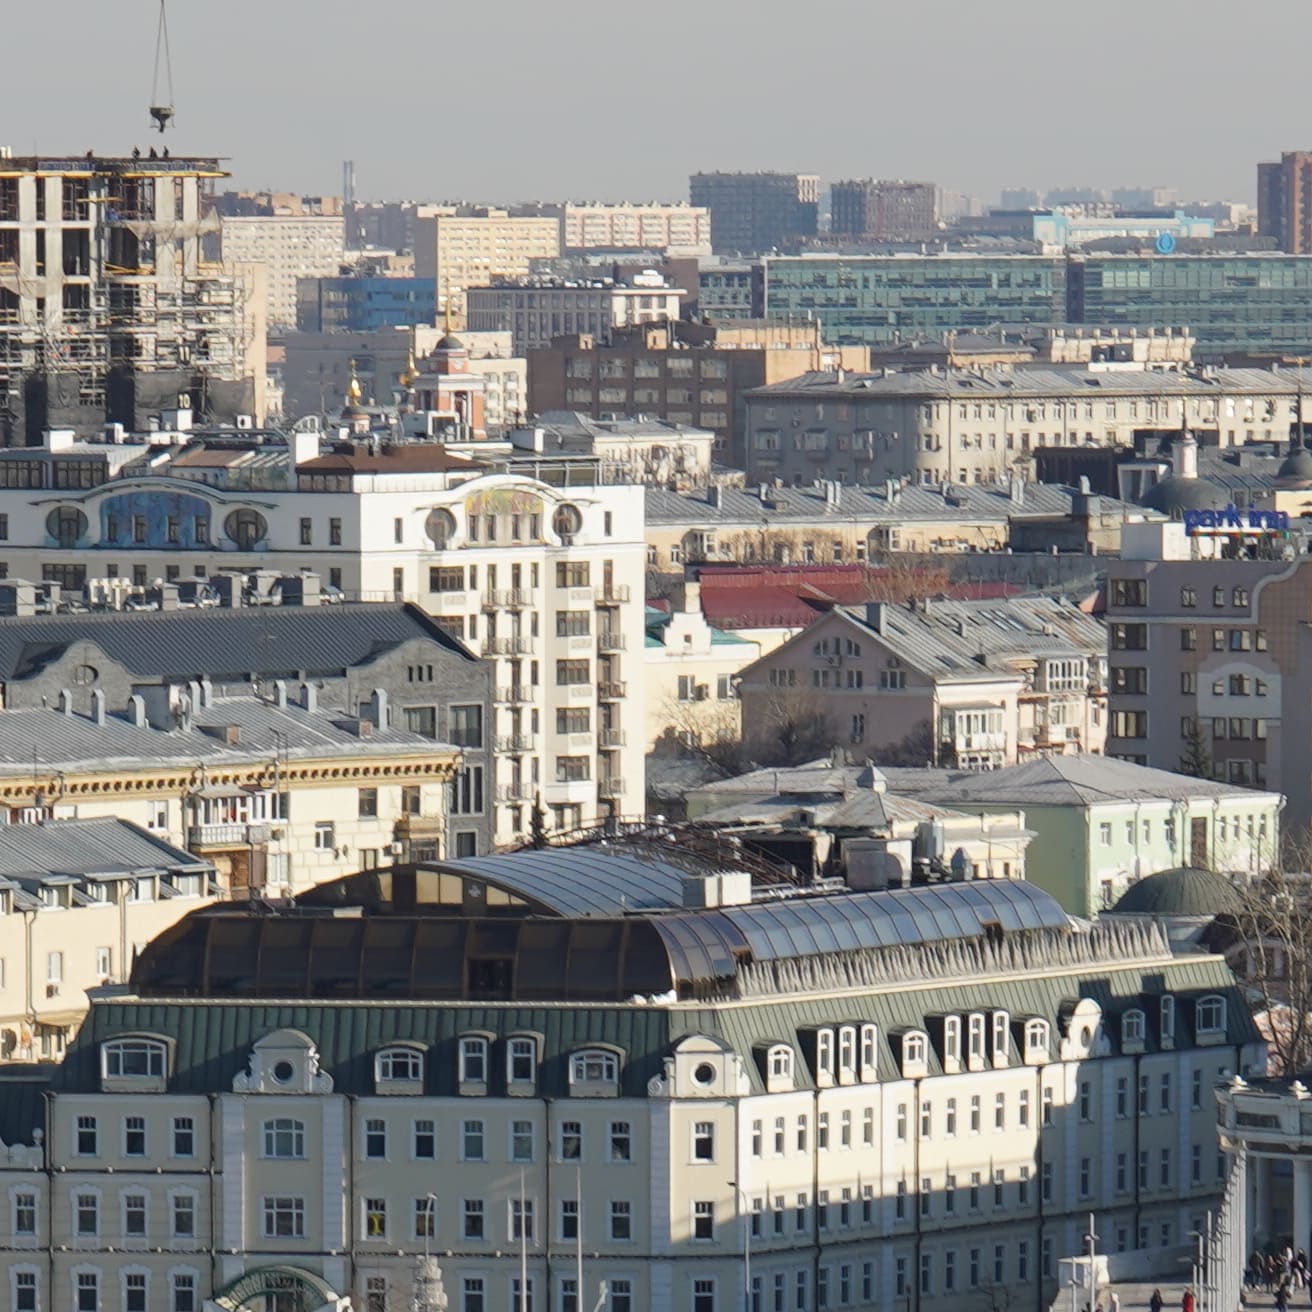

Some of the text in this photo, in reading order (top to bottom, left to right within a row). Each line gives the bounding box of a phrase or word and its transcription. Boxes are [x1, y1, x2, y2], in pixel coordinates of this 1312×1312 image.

[178, 393, 191, 408] 10
[1184, 503, 1289, 537] park inn
